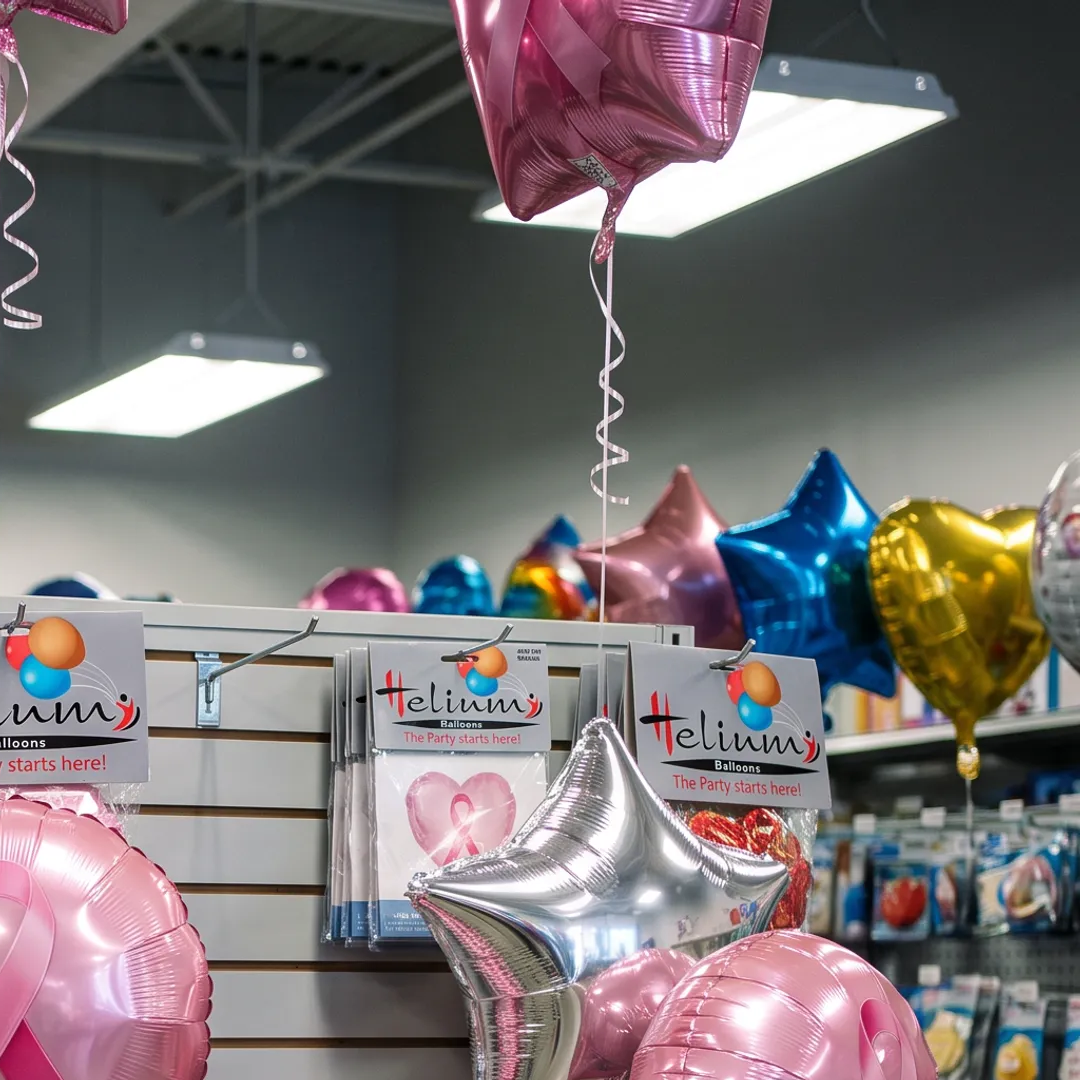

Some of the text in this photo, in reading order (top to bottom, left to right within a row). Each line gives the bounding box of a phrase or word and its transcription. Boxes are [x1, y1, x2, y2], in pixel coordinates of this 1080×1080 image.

[375, 669, 525, 718] Helium
[440, 719, 483, 729] Balloons
[639, 690, 804, 757] Helium
[404, 731, 521, 747] The Party starts here!
[8, 755, 56, 773] starts
[62, 754, 107, 772] here!
[715, 760, 761, 774] Balloons
[673, 775, 802, 797] The Party starts here!
